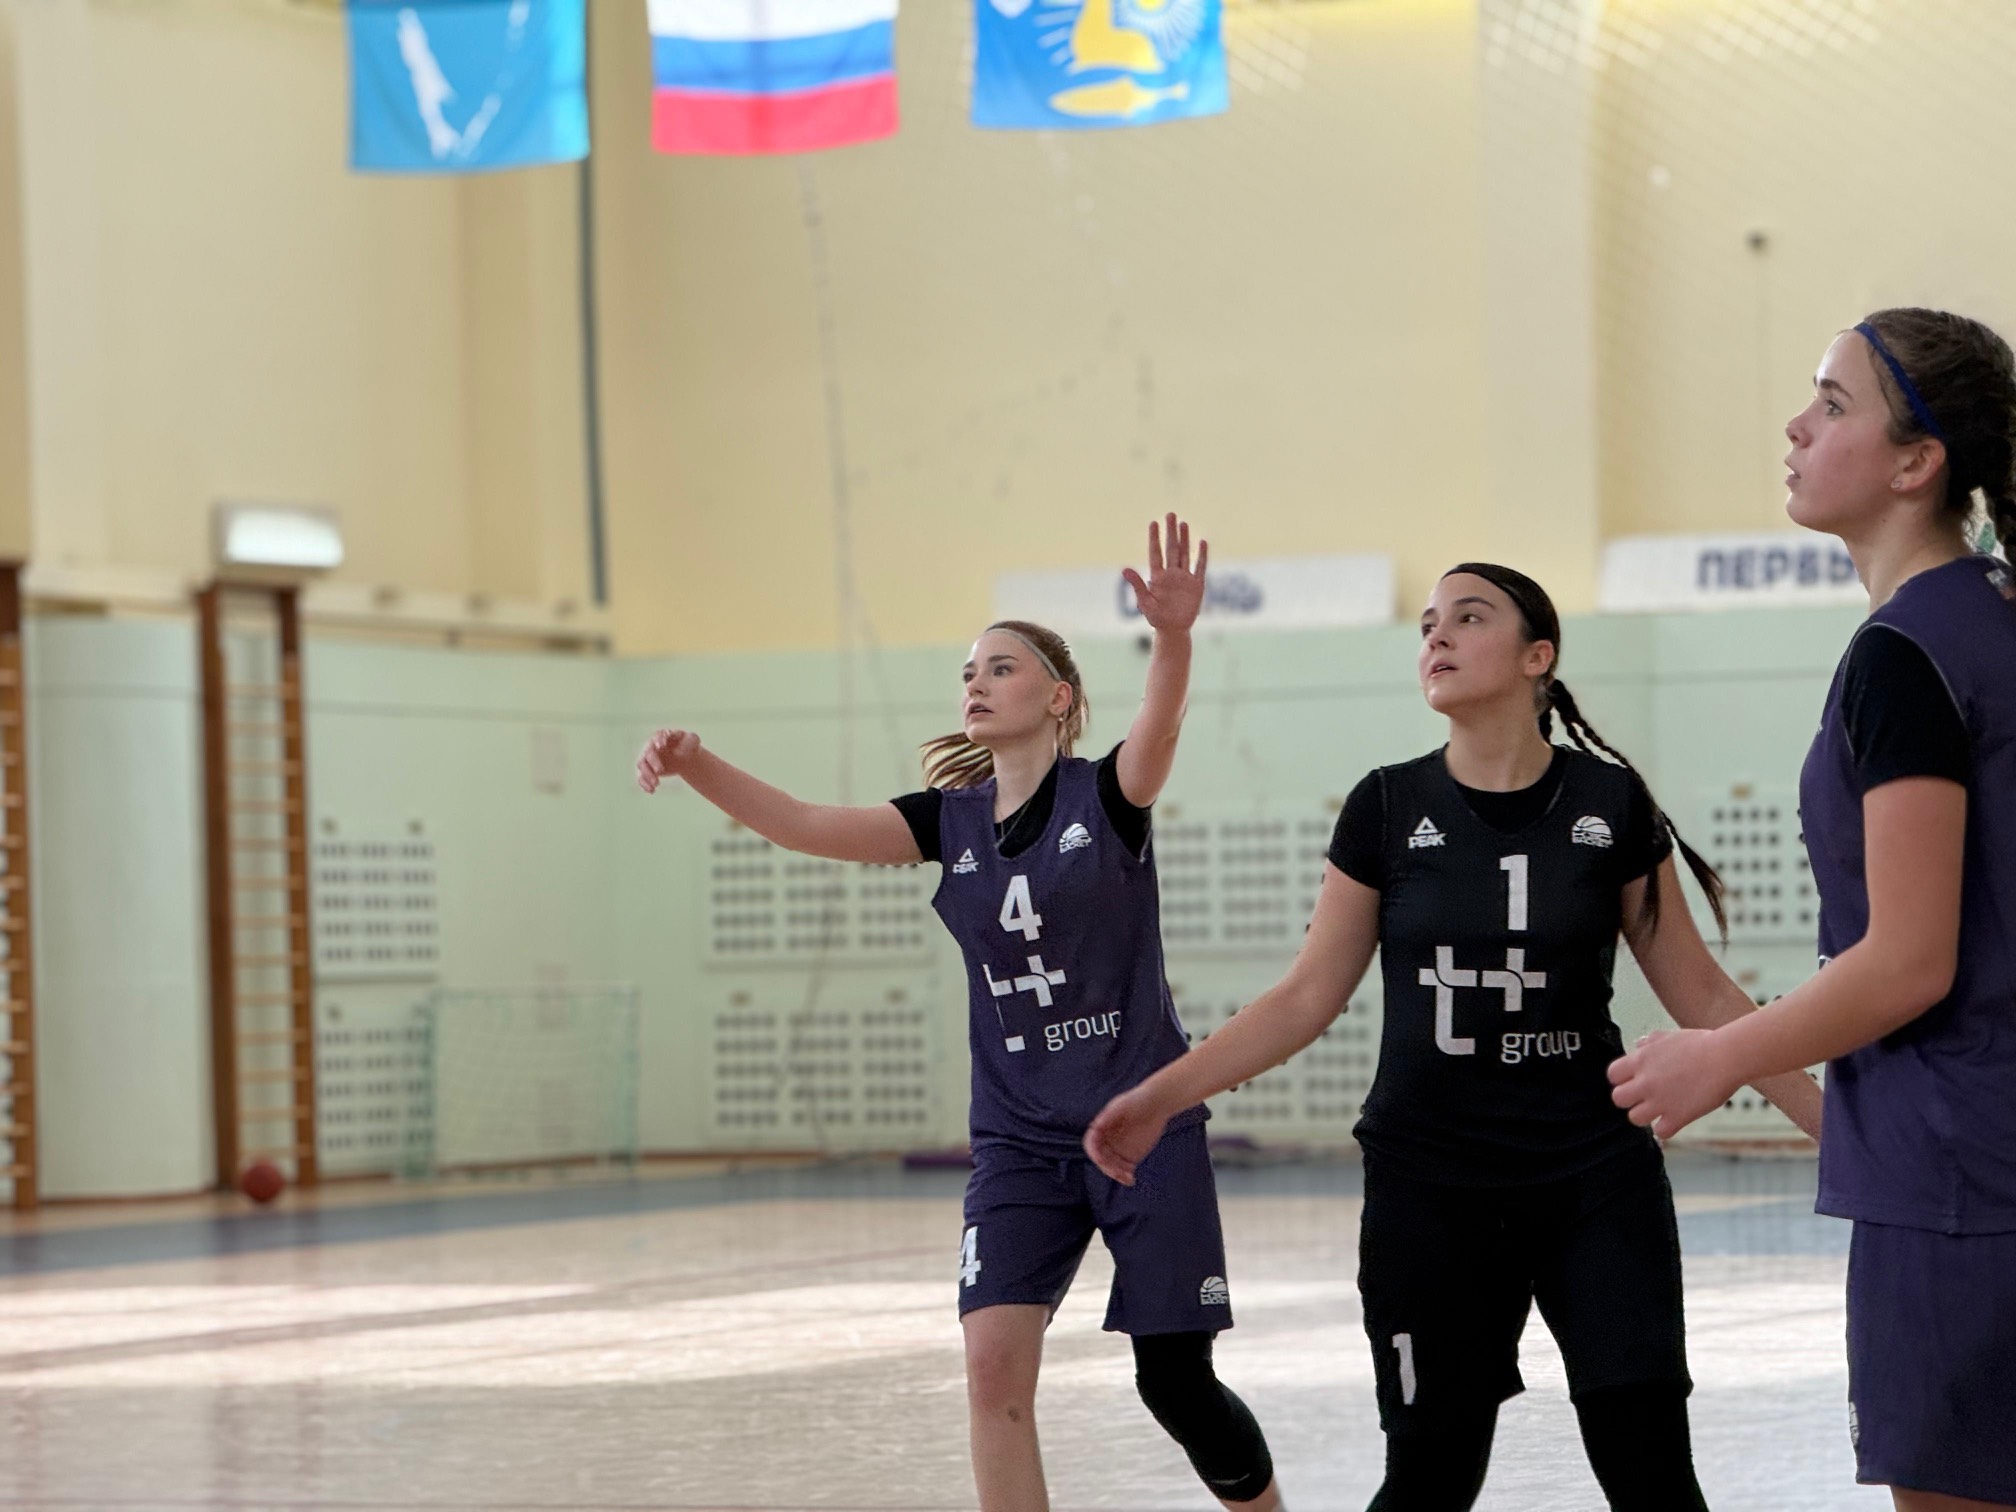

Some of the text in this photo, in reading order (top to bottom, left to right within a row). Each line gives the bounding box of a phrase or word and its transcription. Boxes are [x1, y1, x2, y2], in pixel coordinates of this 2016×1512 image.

[1408, 833, 1448, 849] PEAK
[999, 875, 1042, 941] 4
[1500, 854, 1528, 931] 1
[1044, 1010, 1122, 1051] group
[1501, 1031, 1582, 1064] group
[958, 1226, 981, 1288] 4
[1392, 1333, 1417, 1405] 1
